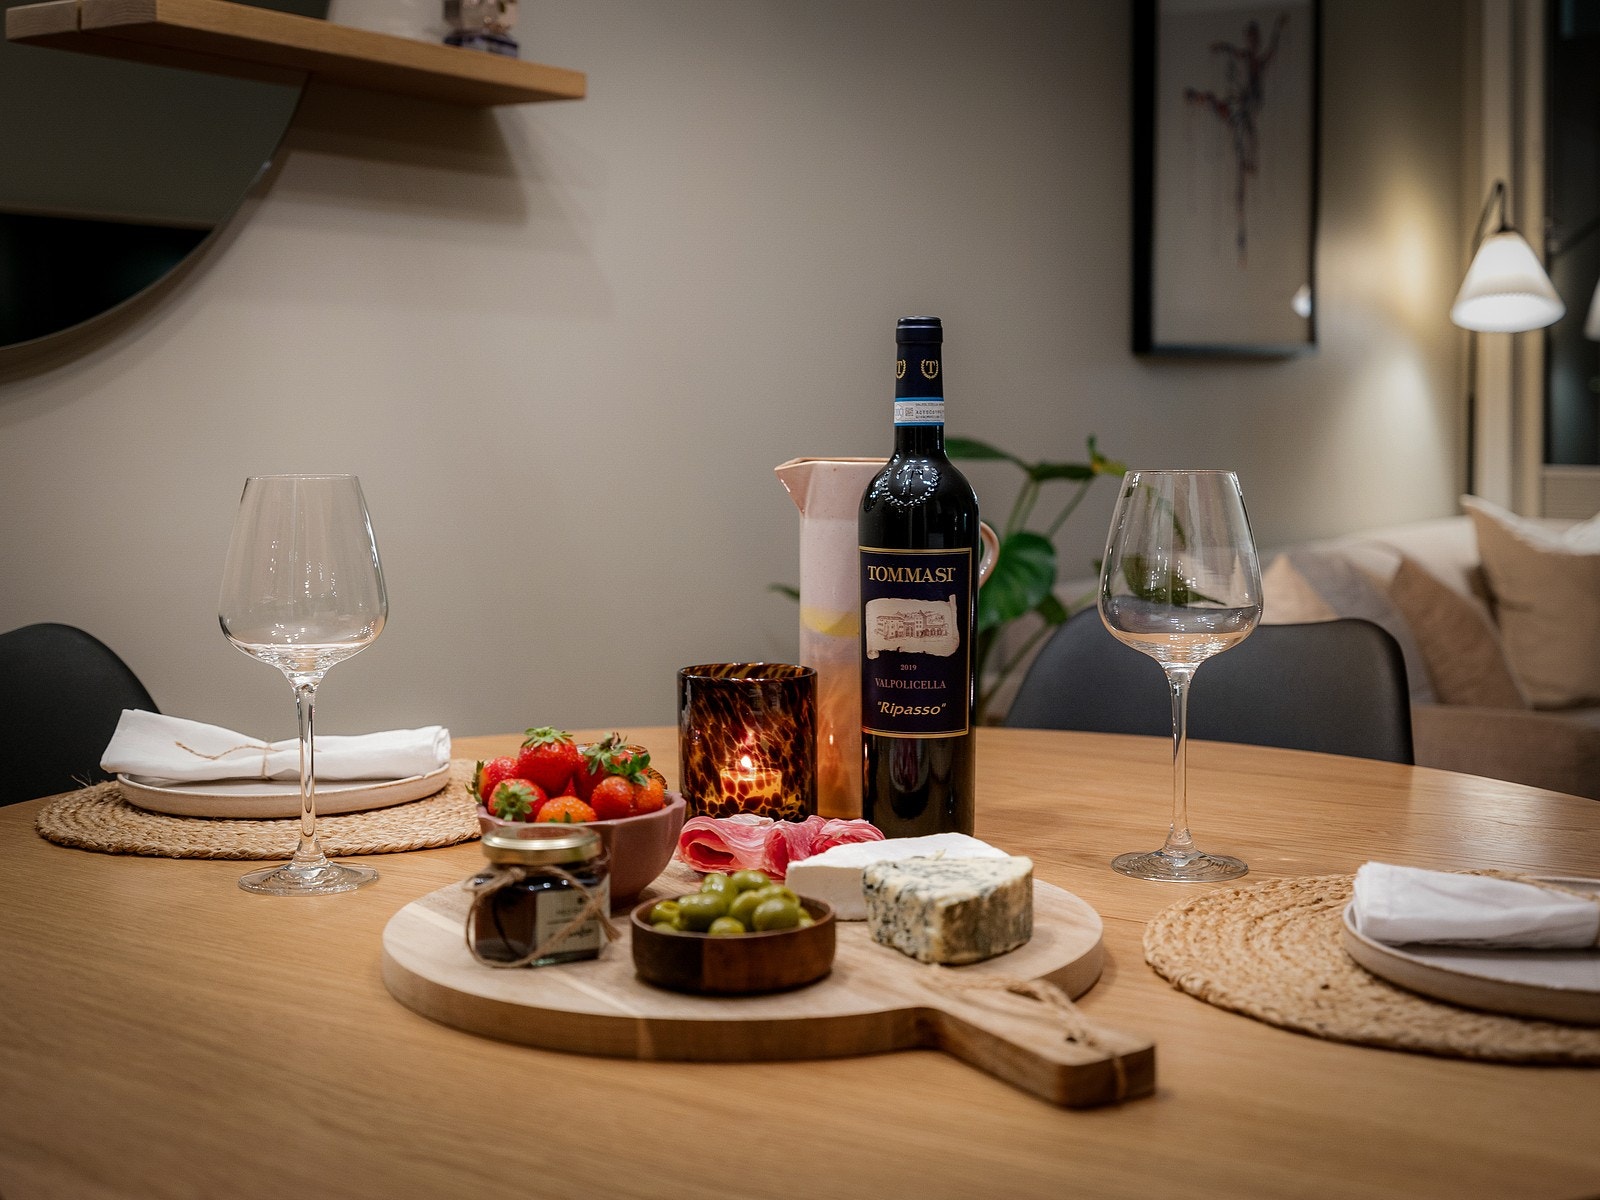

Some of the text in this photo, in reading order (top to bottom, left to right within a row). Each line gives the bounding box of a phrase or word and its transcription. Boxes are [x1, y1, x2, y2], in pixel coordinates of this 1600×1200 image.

[925, 360, 936, 374] T
[867, 565, 955, 583] TOMMASI
[874, 677, 946, 690] VALPOLICELLA
